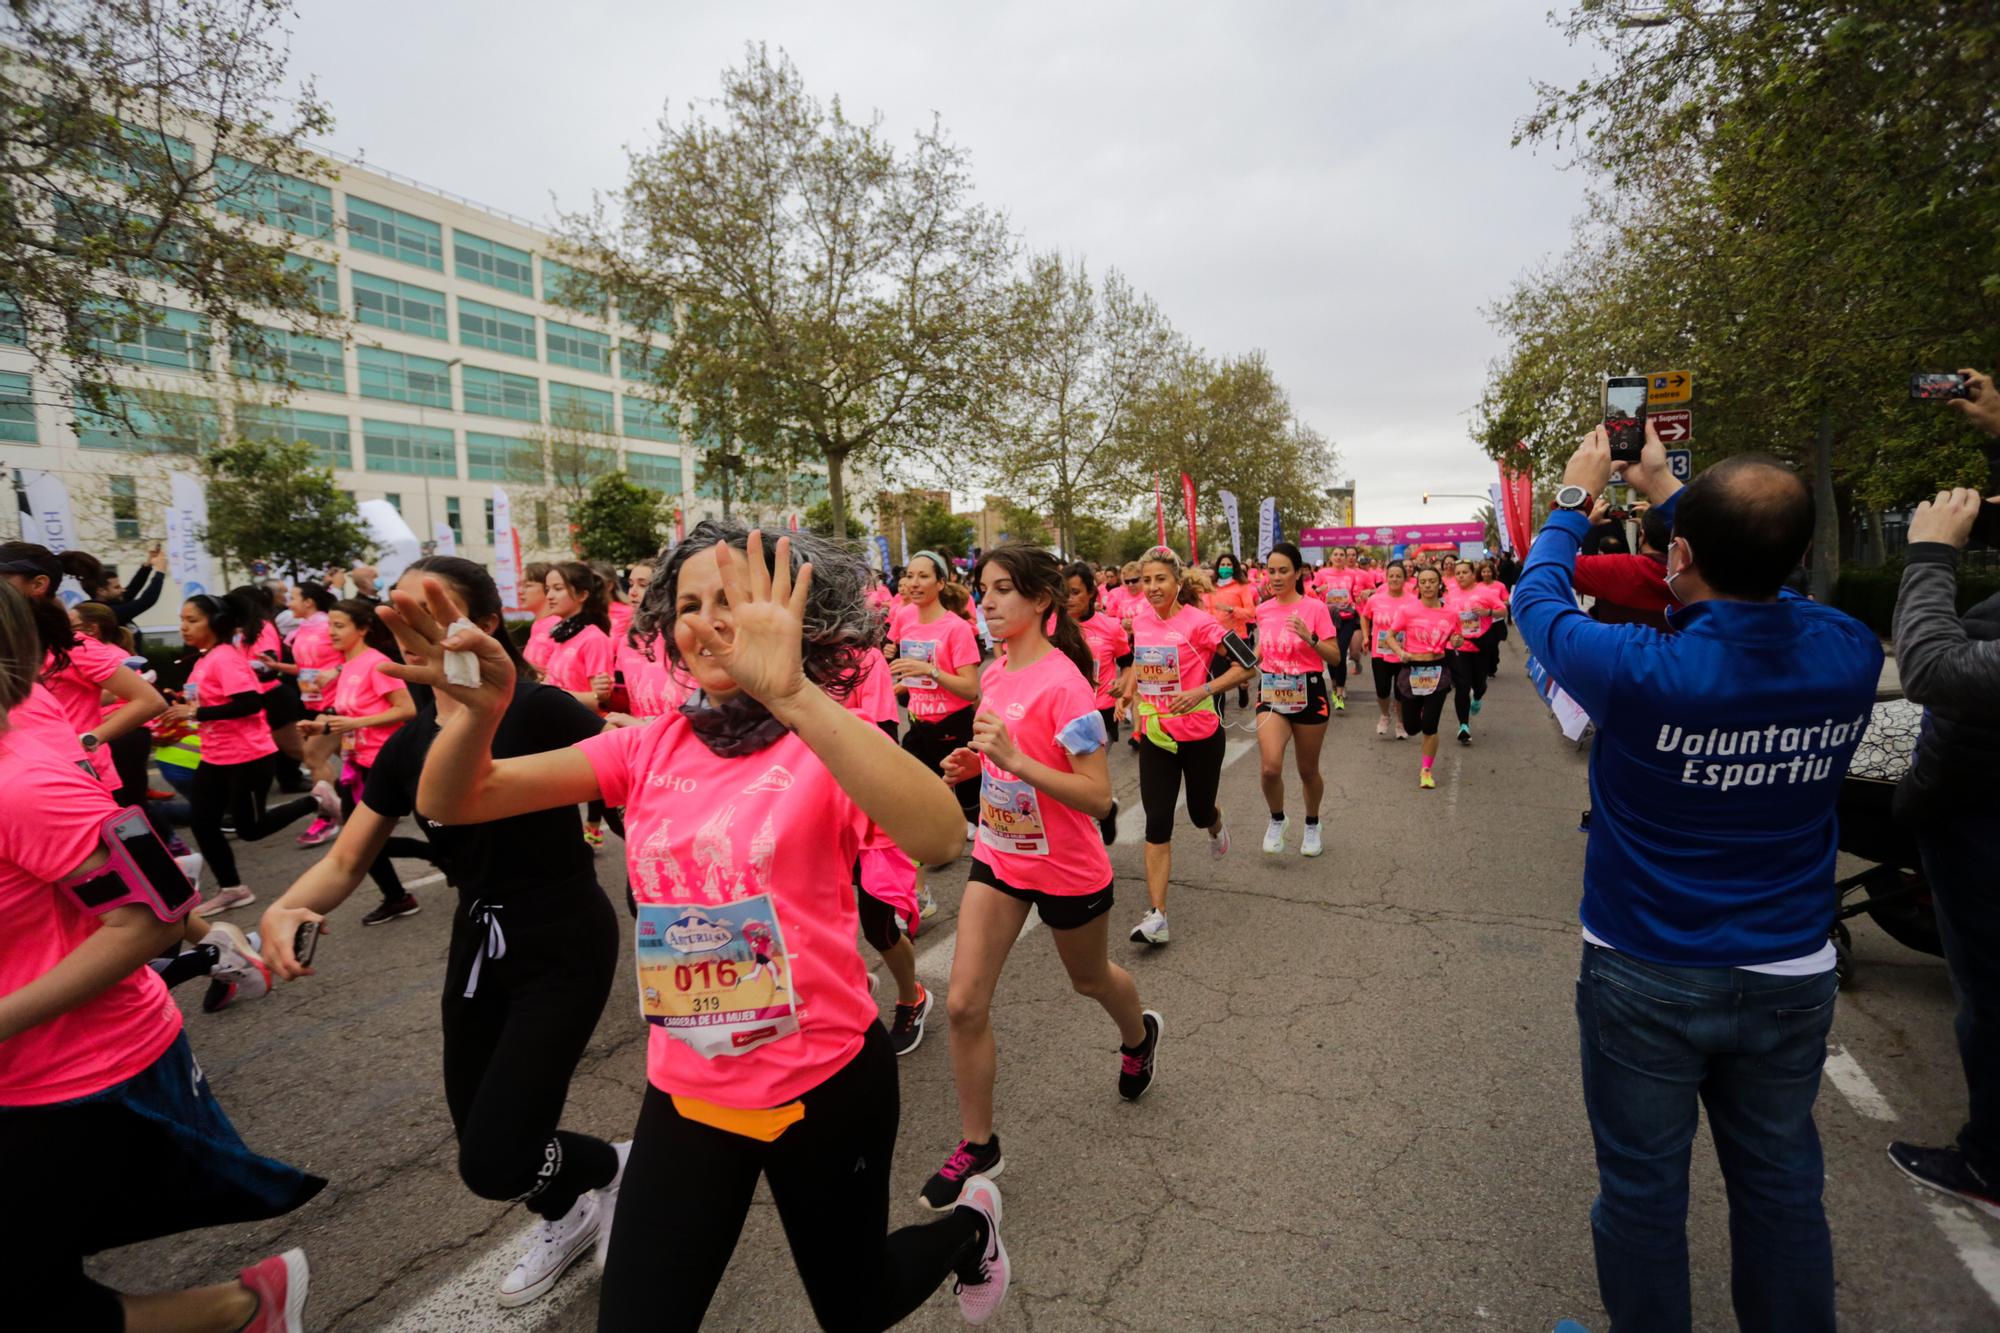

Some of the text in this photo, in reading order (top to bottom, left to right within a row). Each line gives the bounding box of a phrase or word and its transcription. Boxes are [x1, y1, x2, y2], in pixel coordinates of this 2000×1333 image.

[1659, 413, 1688, 424] Superior
[1143, 665, 1163, 674] 016
[912, 693, 947, 701] DORSAL
[1656, 714, 1864, 756] Voluntariat
[1682, 753, 1833, 791] Esportiu
[674, 959, 738, 992] 016
[692, 996, 720, 1012] 319
[663, 1010, 756, 1027] CARRERA DE LA MUJER
